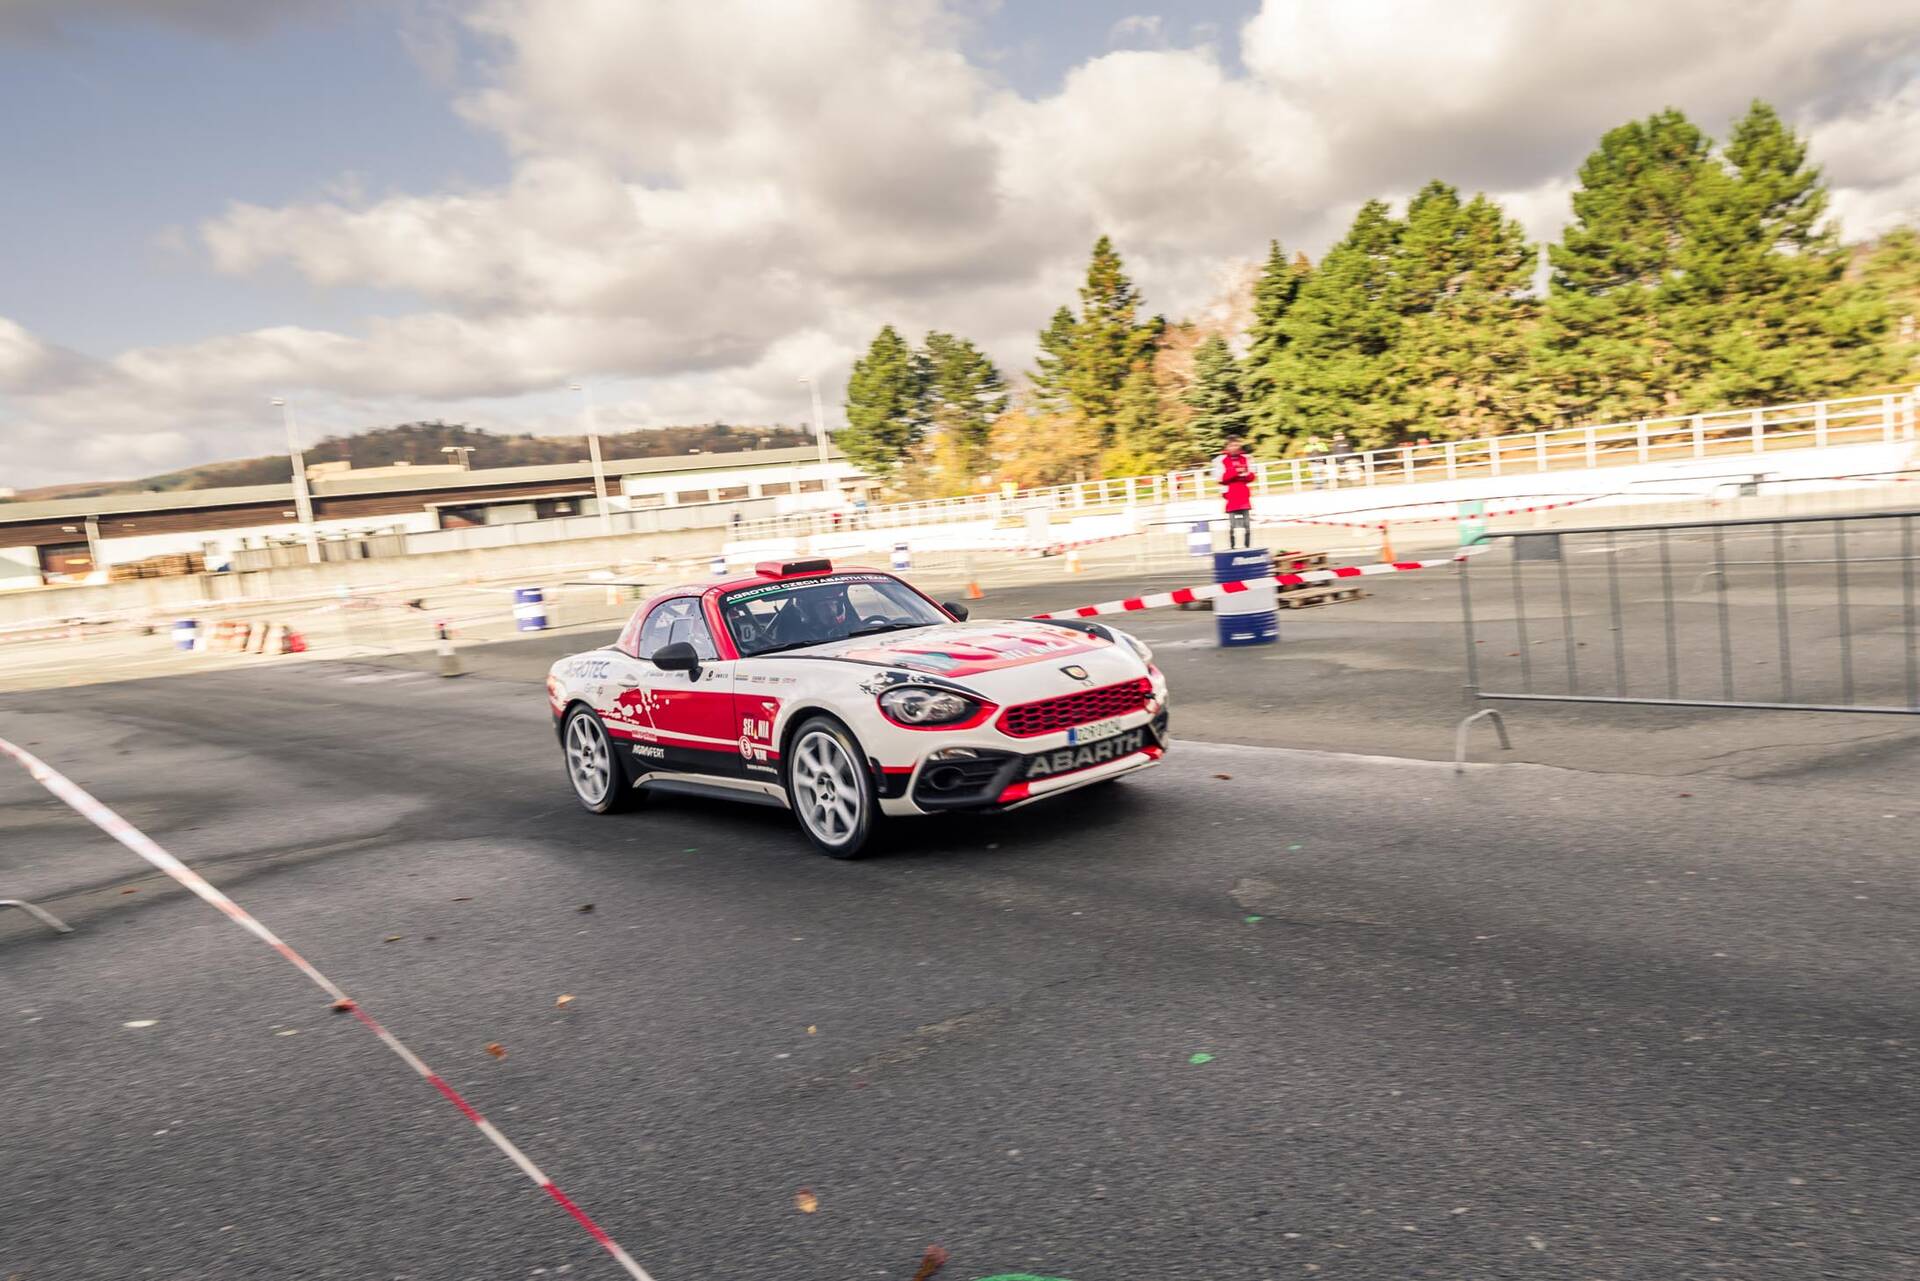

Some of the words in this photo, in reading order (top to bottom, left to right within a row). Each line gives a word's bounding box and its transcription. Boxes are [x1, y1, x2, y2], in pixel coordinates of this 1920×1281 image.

[727, 584, 780, 602] AGROTEC
[781, 579, 818, 589] CZECH
[820, 575, 861, 583] ABARTH
[1026, 729, 1144, 778] ABARTH
